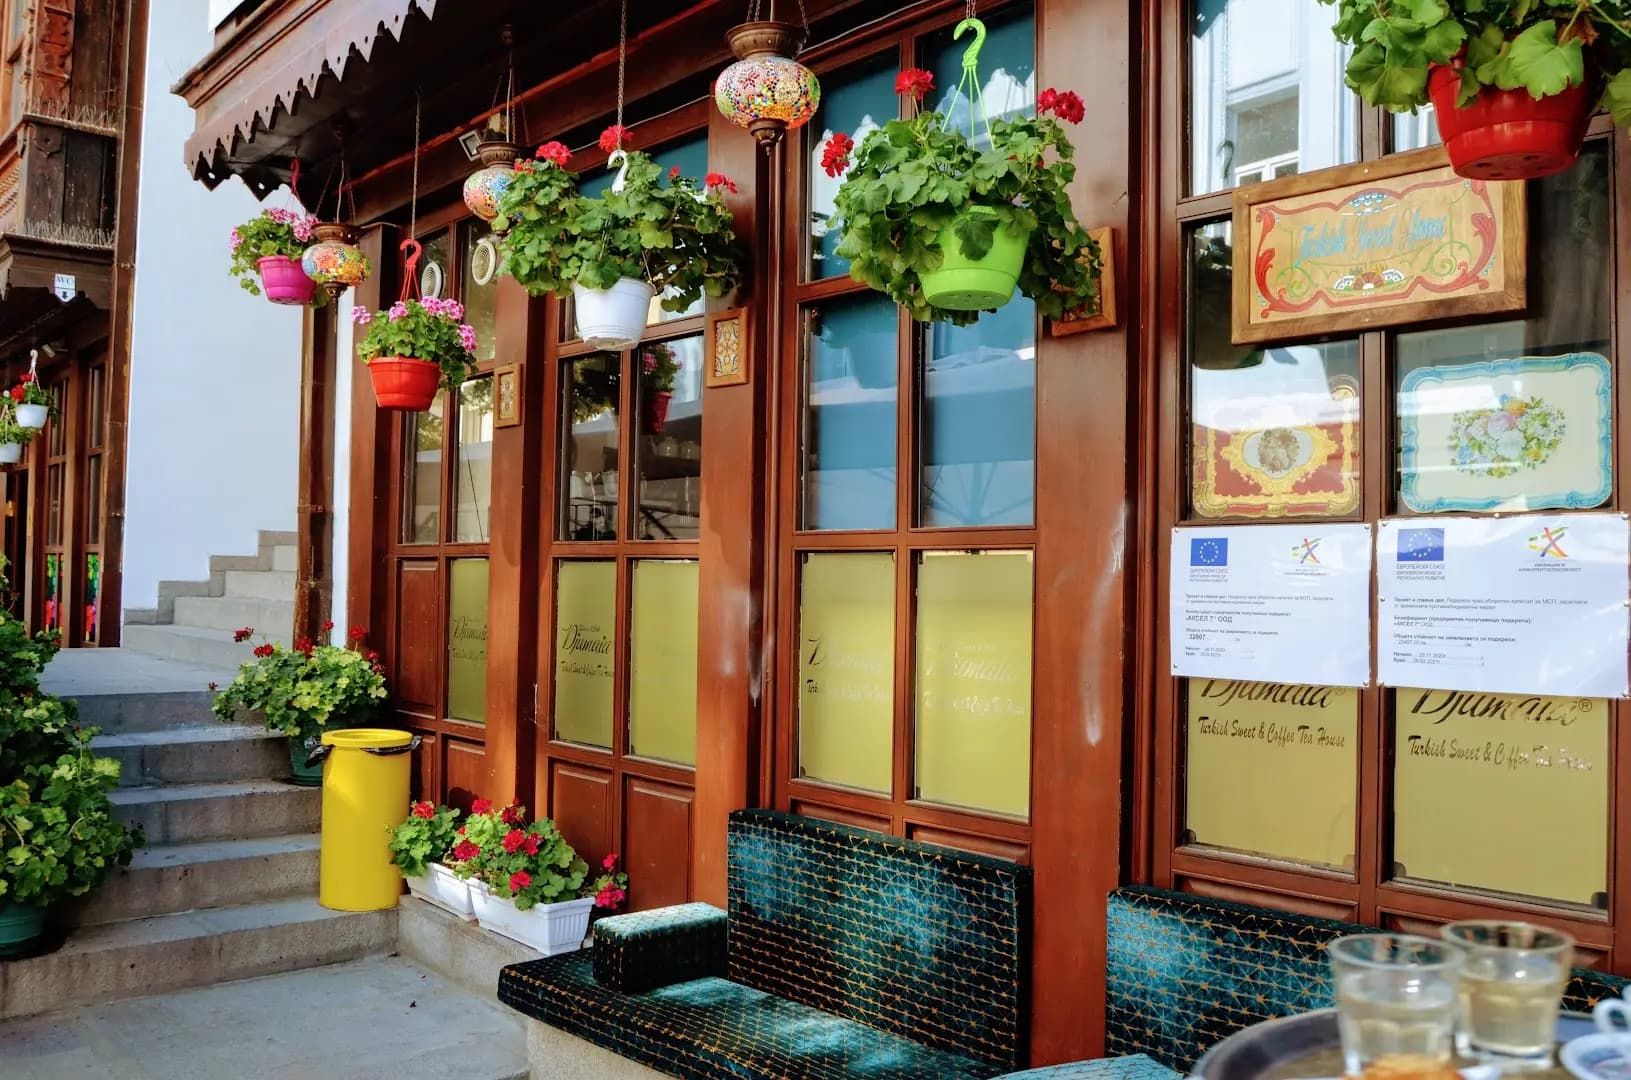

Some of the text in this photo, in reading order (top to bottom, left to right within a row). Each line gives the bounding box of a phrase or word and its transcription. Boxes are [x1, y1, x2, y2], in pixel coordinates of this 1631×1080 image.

[561, 624, 612, 655] Djumaia
[1198, 716, 1345, 748] Turkish Sweet & Coffee Tea House
[1408, 735, 1445, 758] Turkish
[1449, 738, 1480, 761] Sweet
[1483, 741, 1491, 762] &
